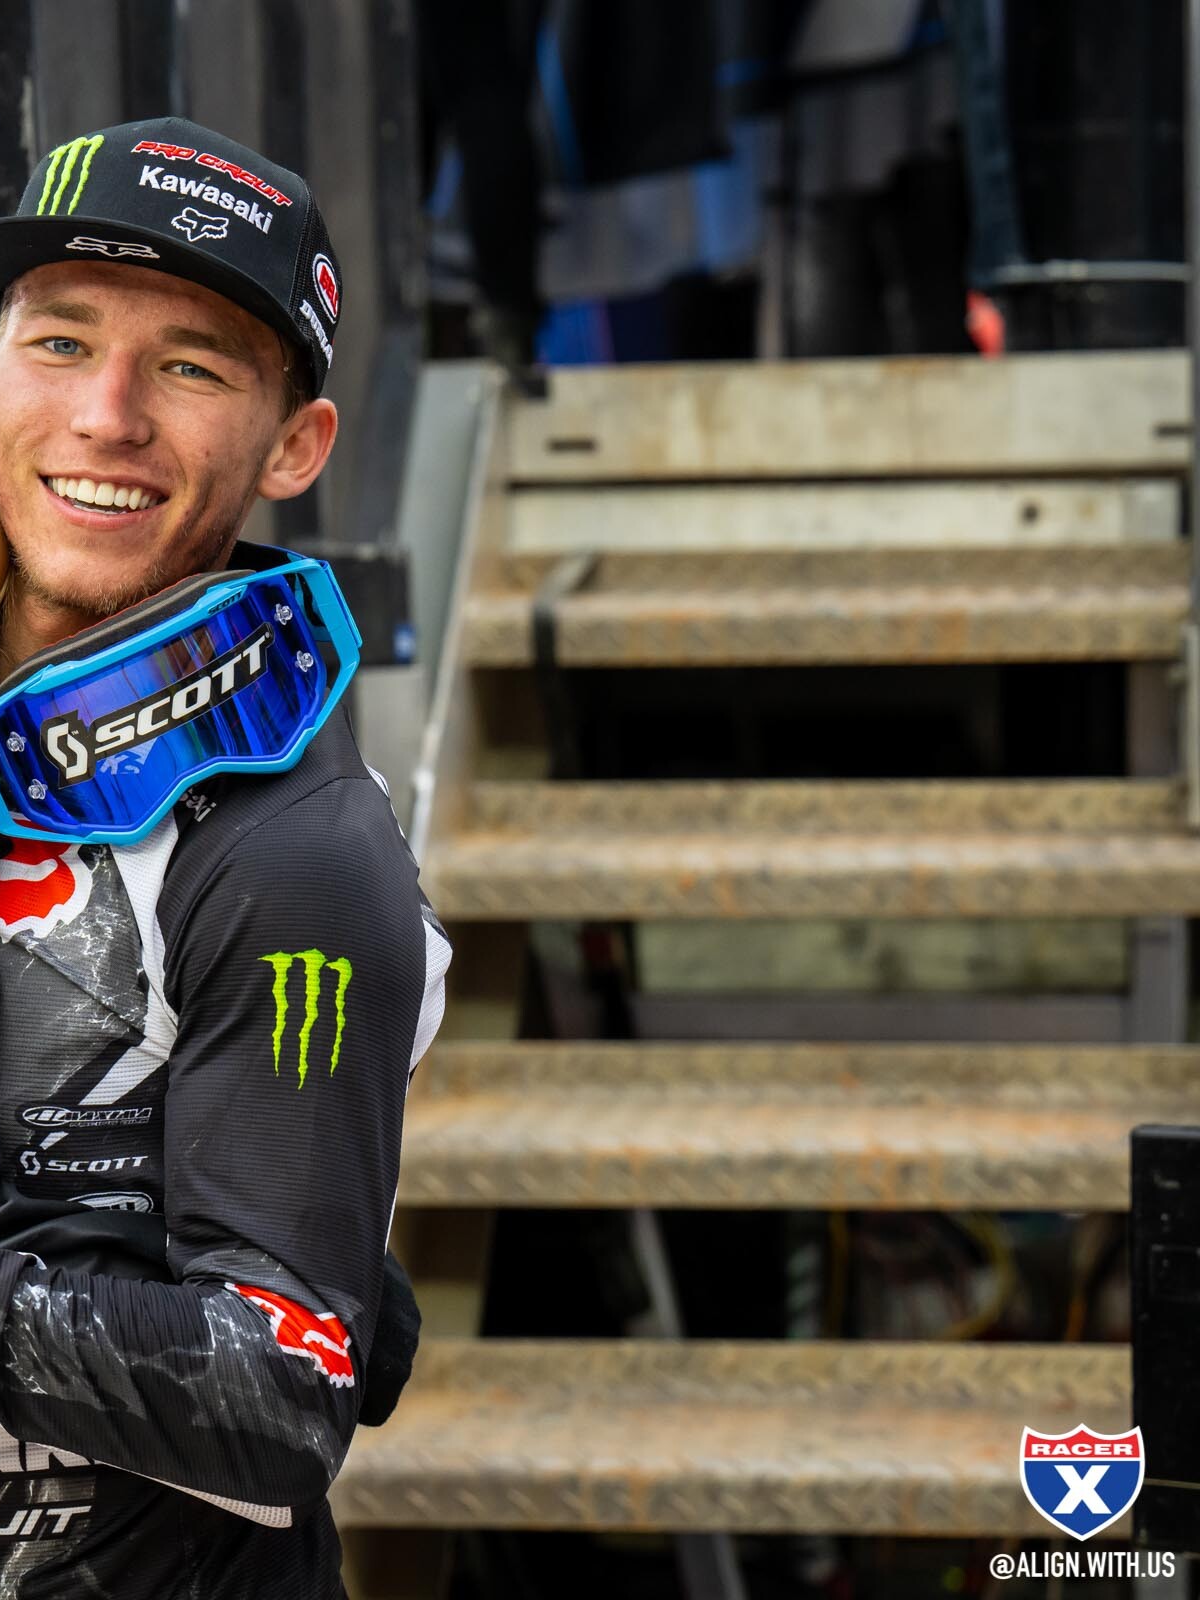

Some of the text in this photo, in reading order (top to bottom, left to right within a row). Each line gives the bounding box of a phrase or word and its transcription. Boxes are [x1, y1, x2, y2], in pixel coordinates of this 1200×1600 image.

[131, 140, 292, 206] PRO CIRCUIT
[139, 165, 273, 234] Kawasaki
[95, 633, 268, 754] SCOTT
[45, 1156, 148, 1172] SCOTT
